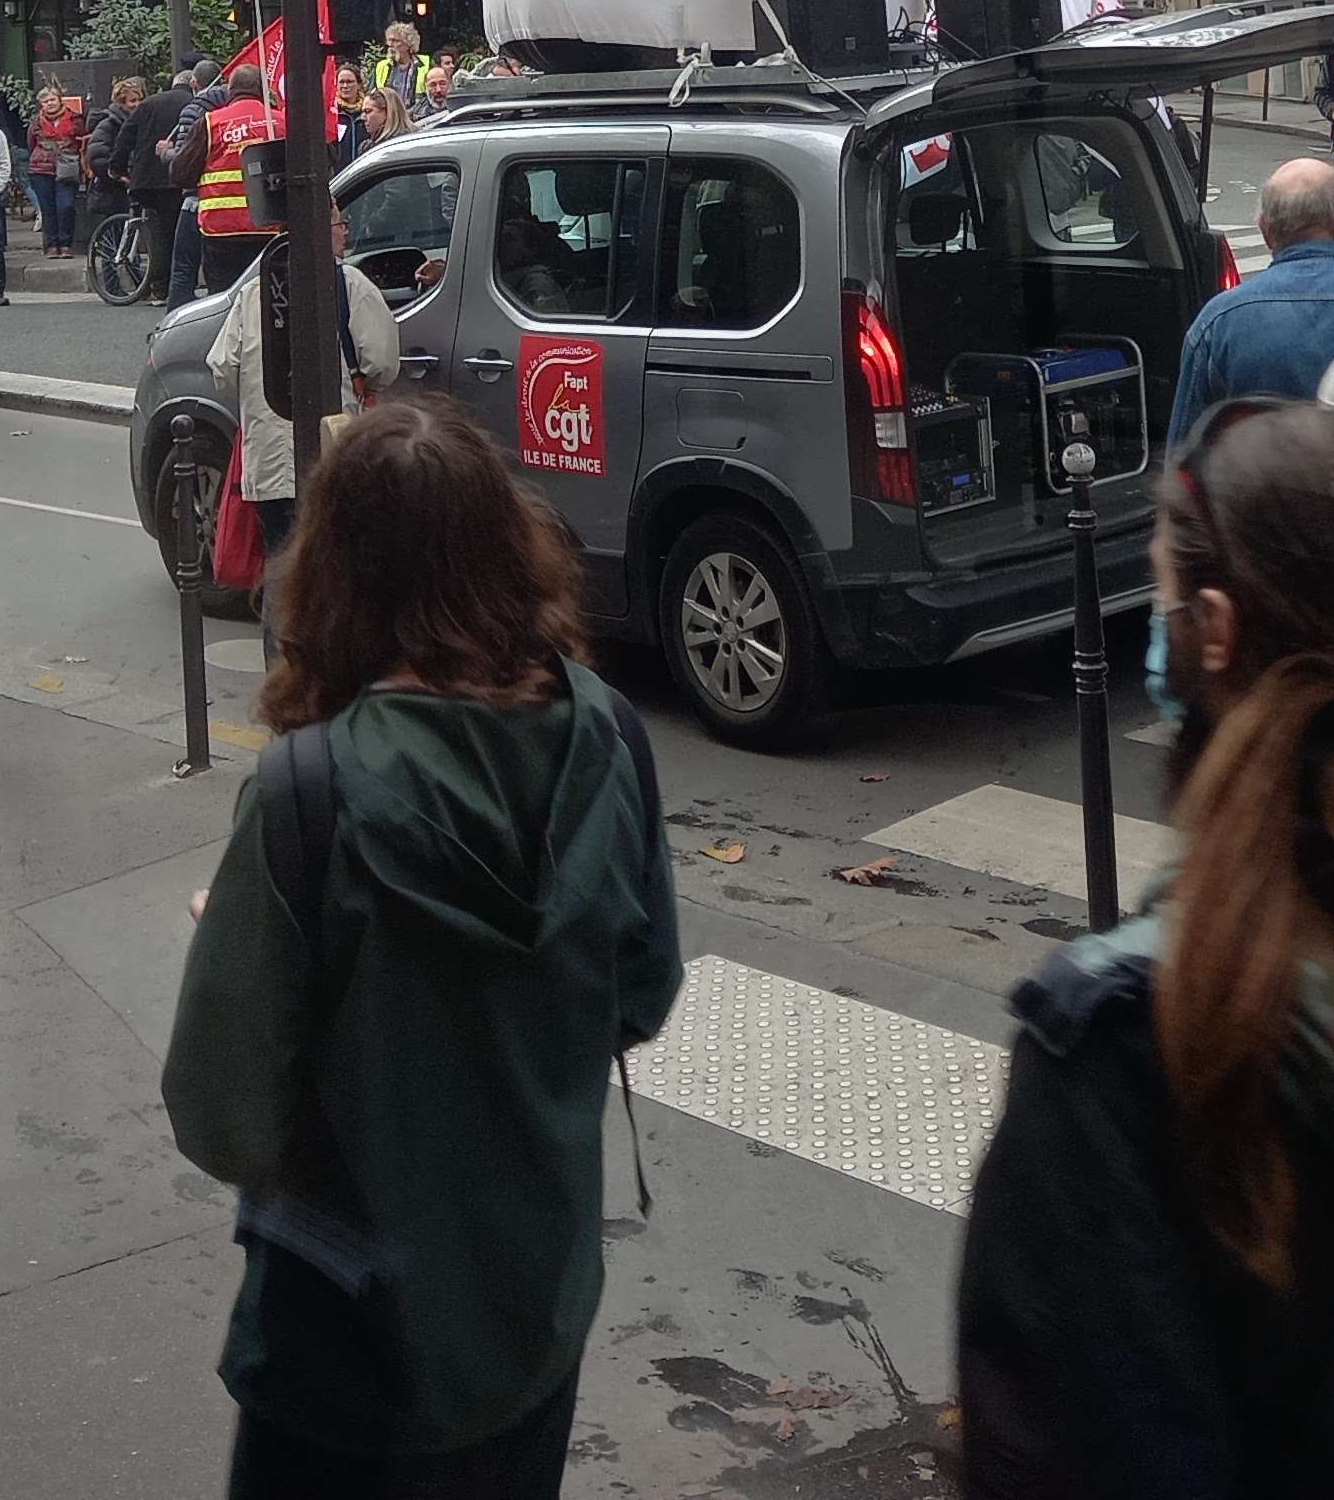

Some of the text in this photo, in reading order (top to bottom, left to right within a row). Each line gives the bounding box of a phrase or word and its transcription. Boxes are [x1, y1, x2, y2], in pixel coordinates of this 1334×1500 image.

[222, 124, 248, 142] cgt
[564, 371, 588, 393] Fapt
[545, 404, 593, 452] cgt
[523, 449, 601, 473] ILE DE FRANCE
